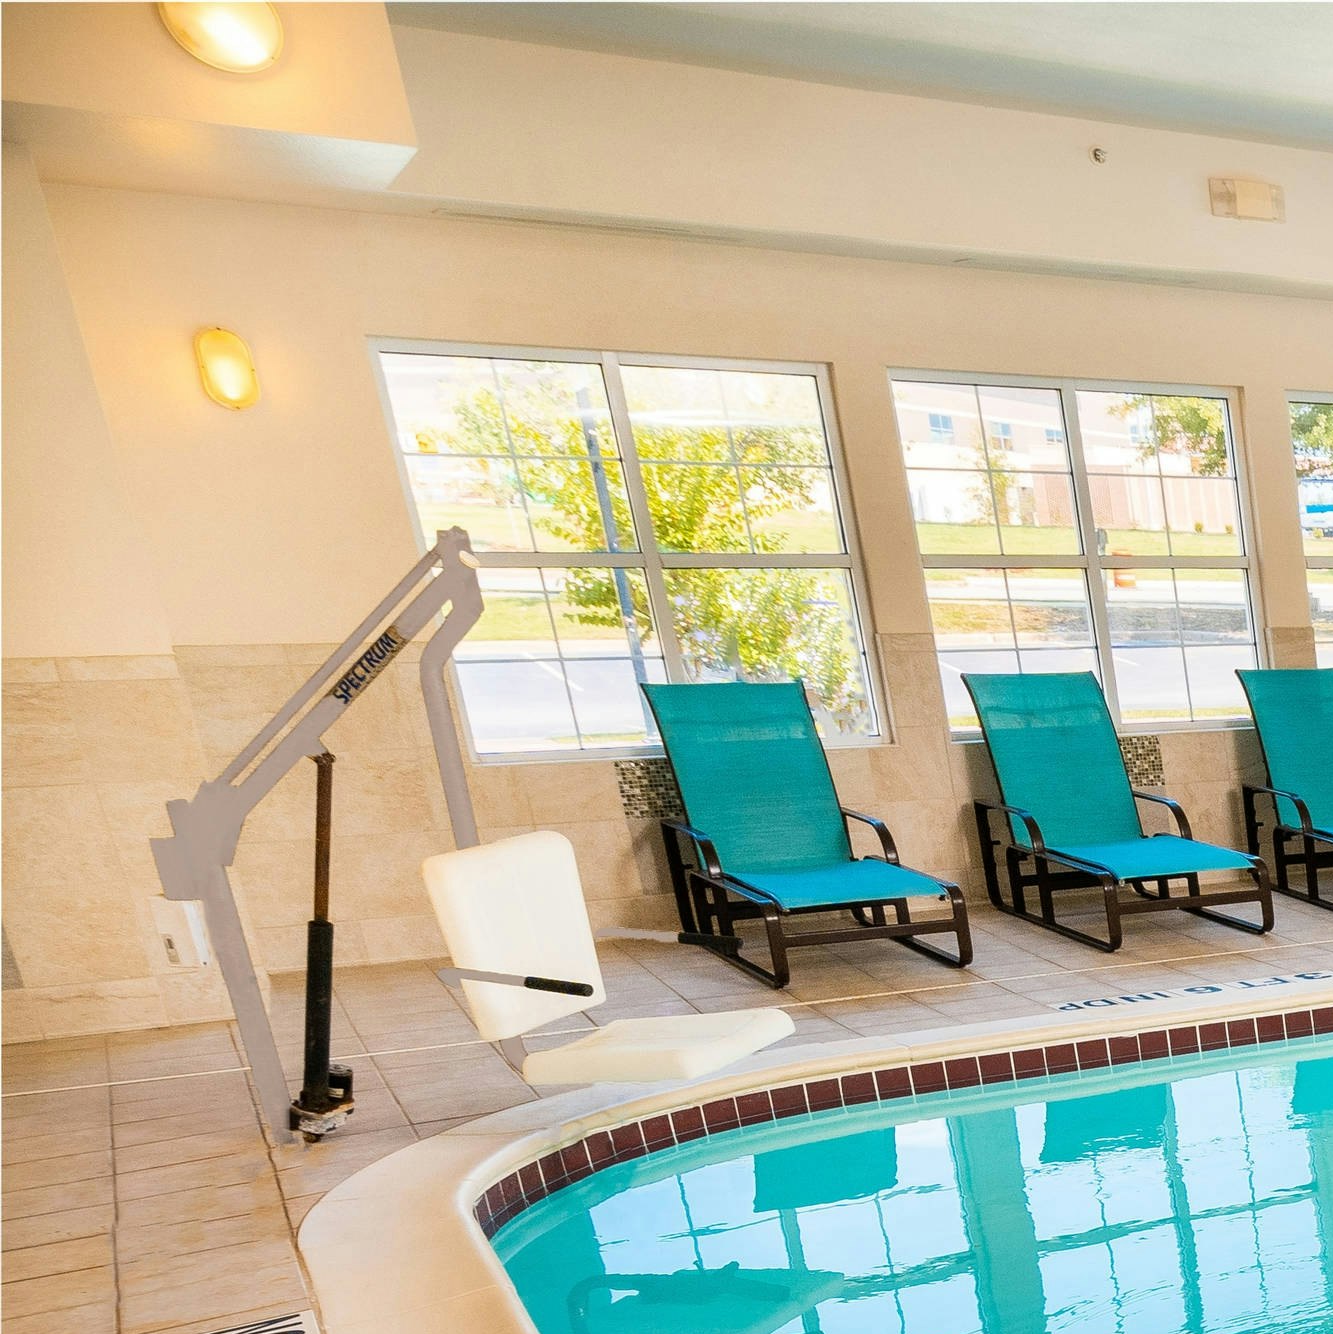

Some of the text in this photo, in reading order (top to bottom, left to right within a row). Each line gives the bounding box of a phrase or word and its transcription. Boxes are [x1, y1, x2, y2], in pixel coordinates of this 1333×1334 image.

[333, 631, 398, 704] SPECTRUM
[1238, 976, 1291, 989] FT
[1293, 972, 1333, 980] 3
